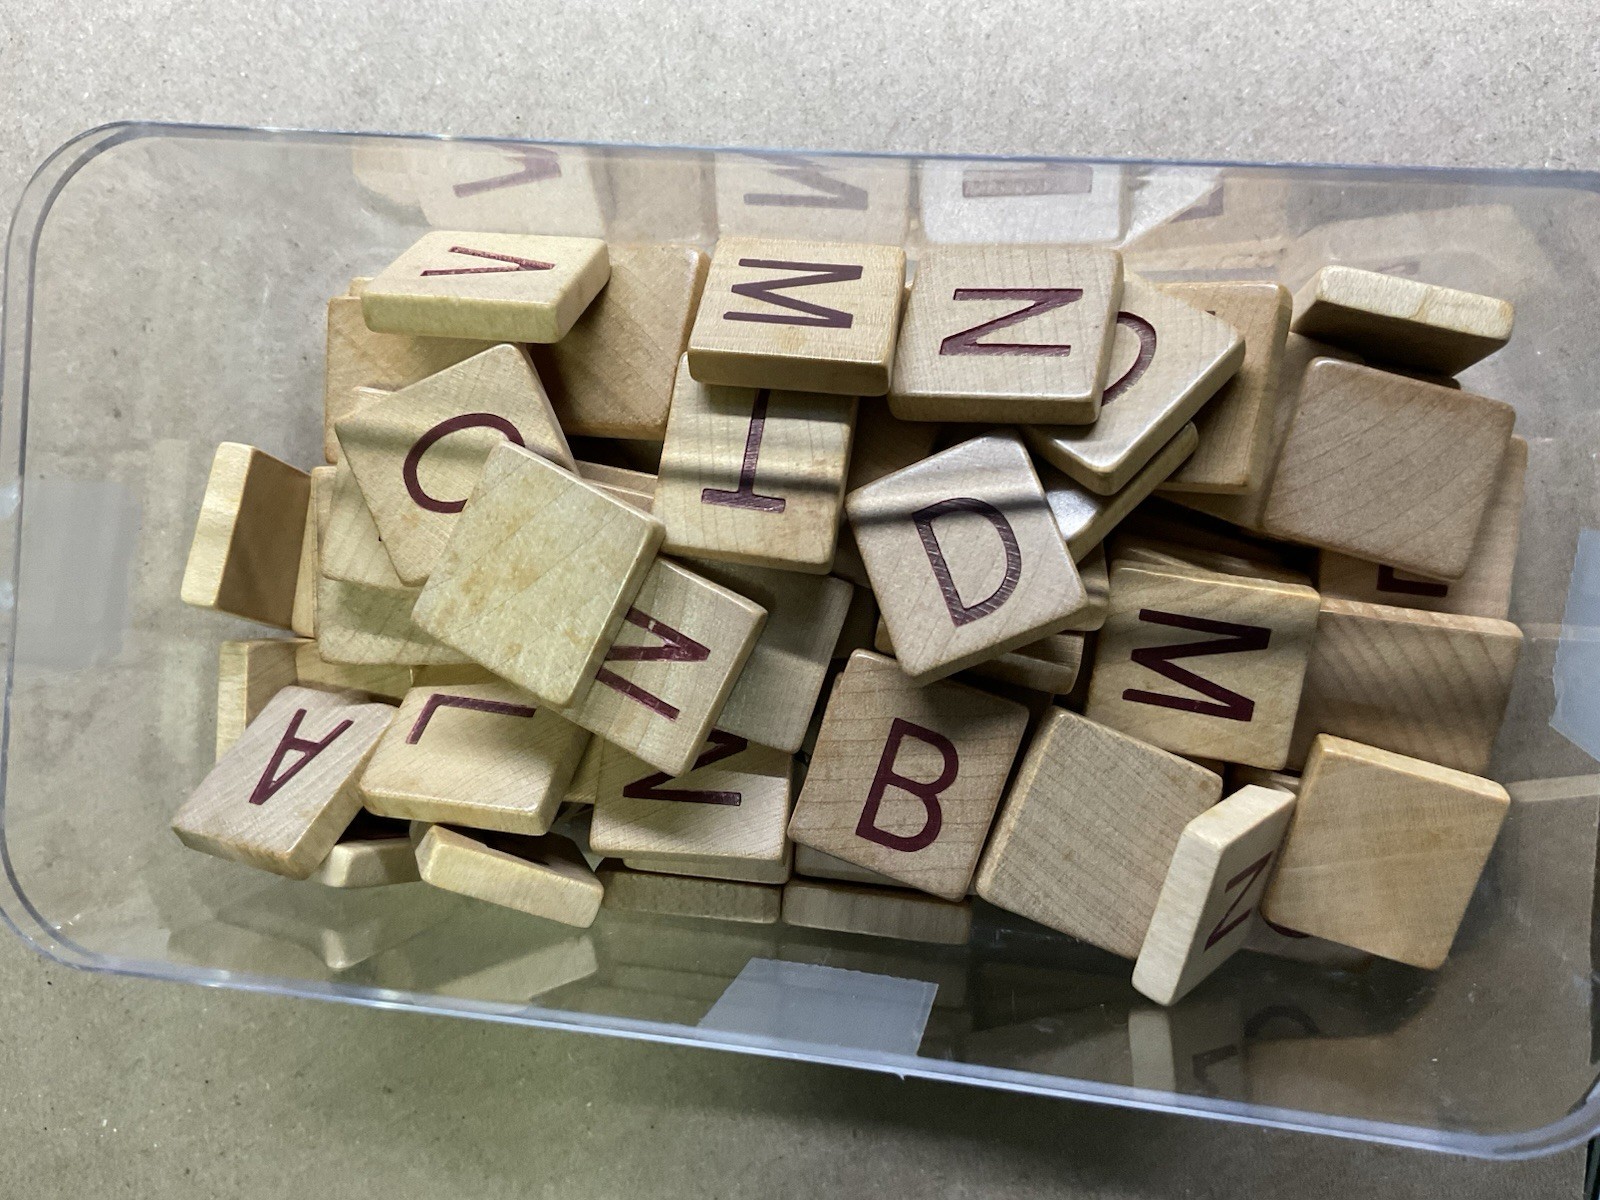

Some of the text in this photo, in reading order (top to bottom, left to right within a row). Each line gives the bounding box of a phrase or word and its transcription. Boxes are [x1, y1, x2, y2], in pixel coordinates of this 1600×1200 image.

[420, 245, 556, 277] V
[722, 258, 864, 329] M
[911, 497, 1022, 628] D
[1122, 608, 1272, 722] M
[248, 708, 355, 806] A
[405, 693, 538, 745] L
[855, 717, 959, 853] B
